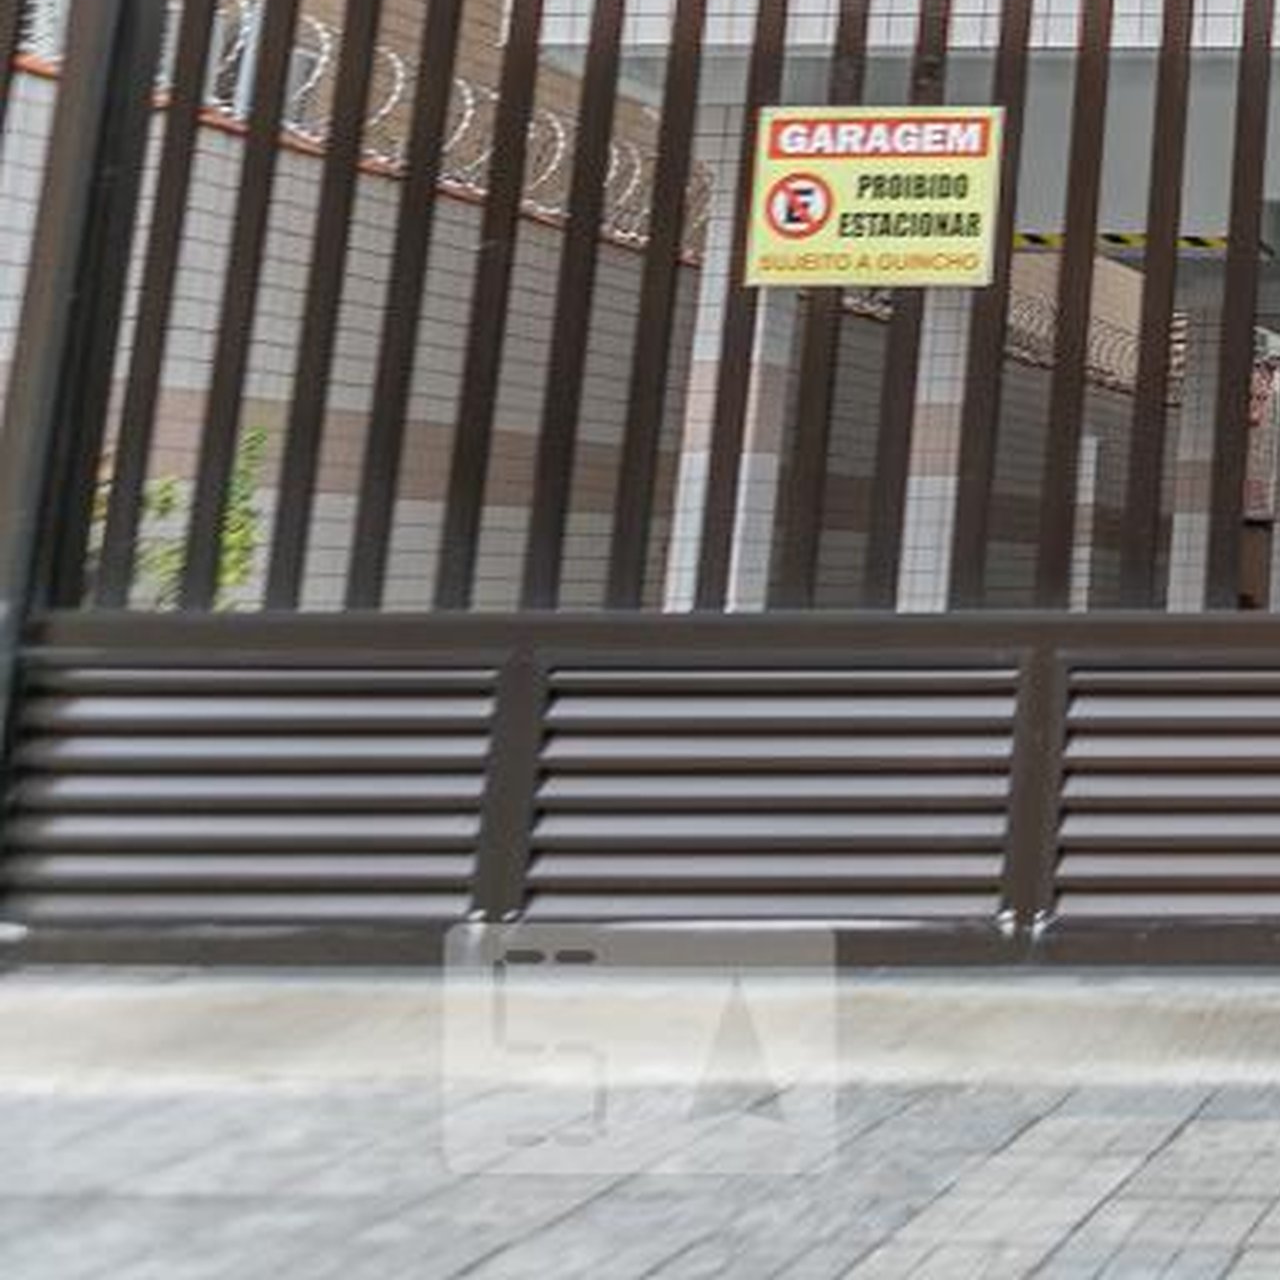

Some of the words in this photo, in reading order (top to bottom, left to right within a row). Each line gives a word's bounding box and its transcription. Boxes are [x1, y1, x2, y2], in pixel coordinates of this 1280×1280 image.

[778, 122, 983, 154] GARAGEM
[856, 173, 970, 199] PROIBIDO
[838, 212, 982, 238] ESTACIONAR
